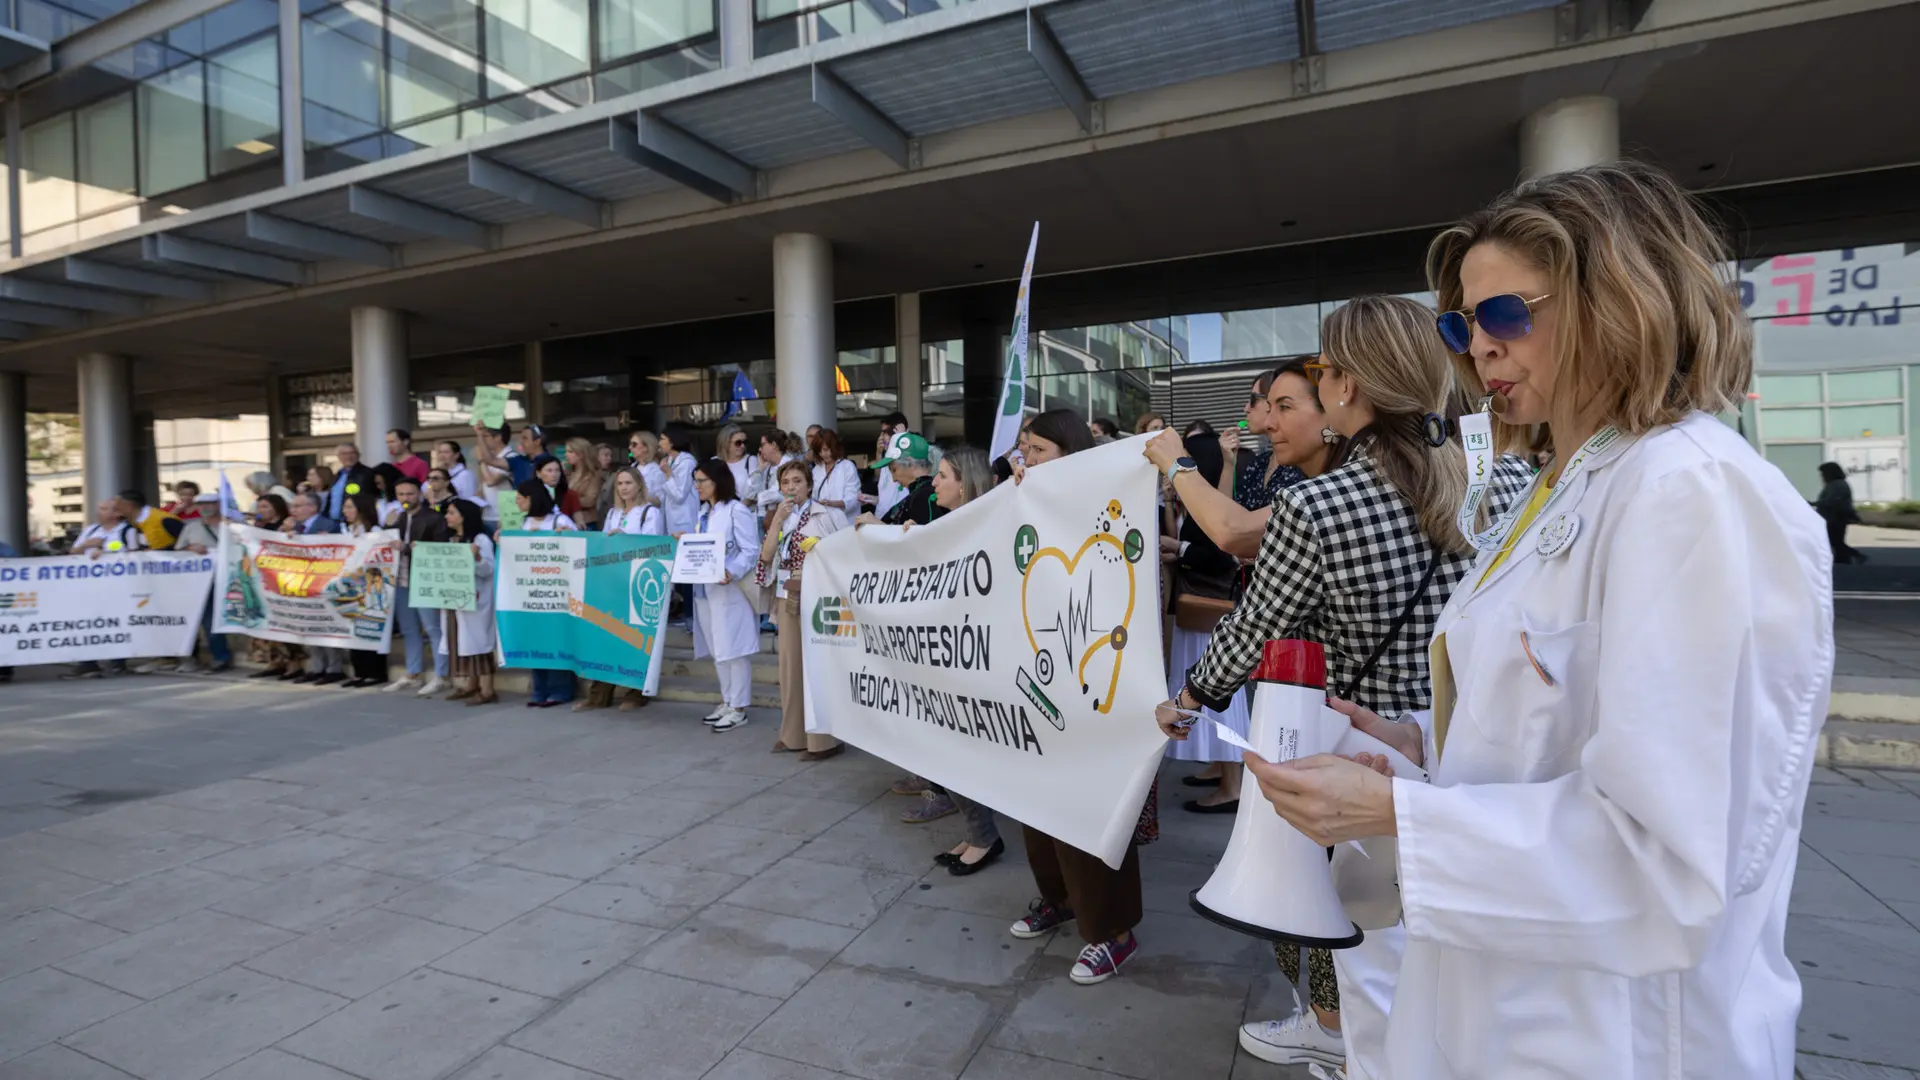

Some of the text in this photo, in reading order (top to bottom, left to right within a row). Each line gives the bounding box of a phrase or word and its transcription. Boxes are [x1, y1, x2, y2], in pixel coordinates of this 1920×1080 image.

[530, 542, 560, 550] POR UN
[1, 558, 212, 582] DE ATENCIÓN PRIMARIA
[850, 550, 992, 604] POR UN ESTATUTO
[27, 616, 119, 633] ATENCIÓN
[17, 633, 132, 650] DE CALIDAD!
[861, 614, 990, 671] DE LA PROFESIÓN
[850, 666, 1043, 756] MÉDICA Y FACULTATIVA
